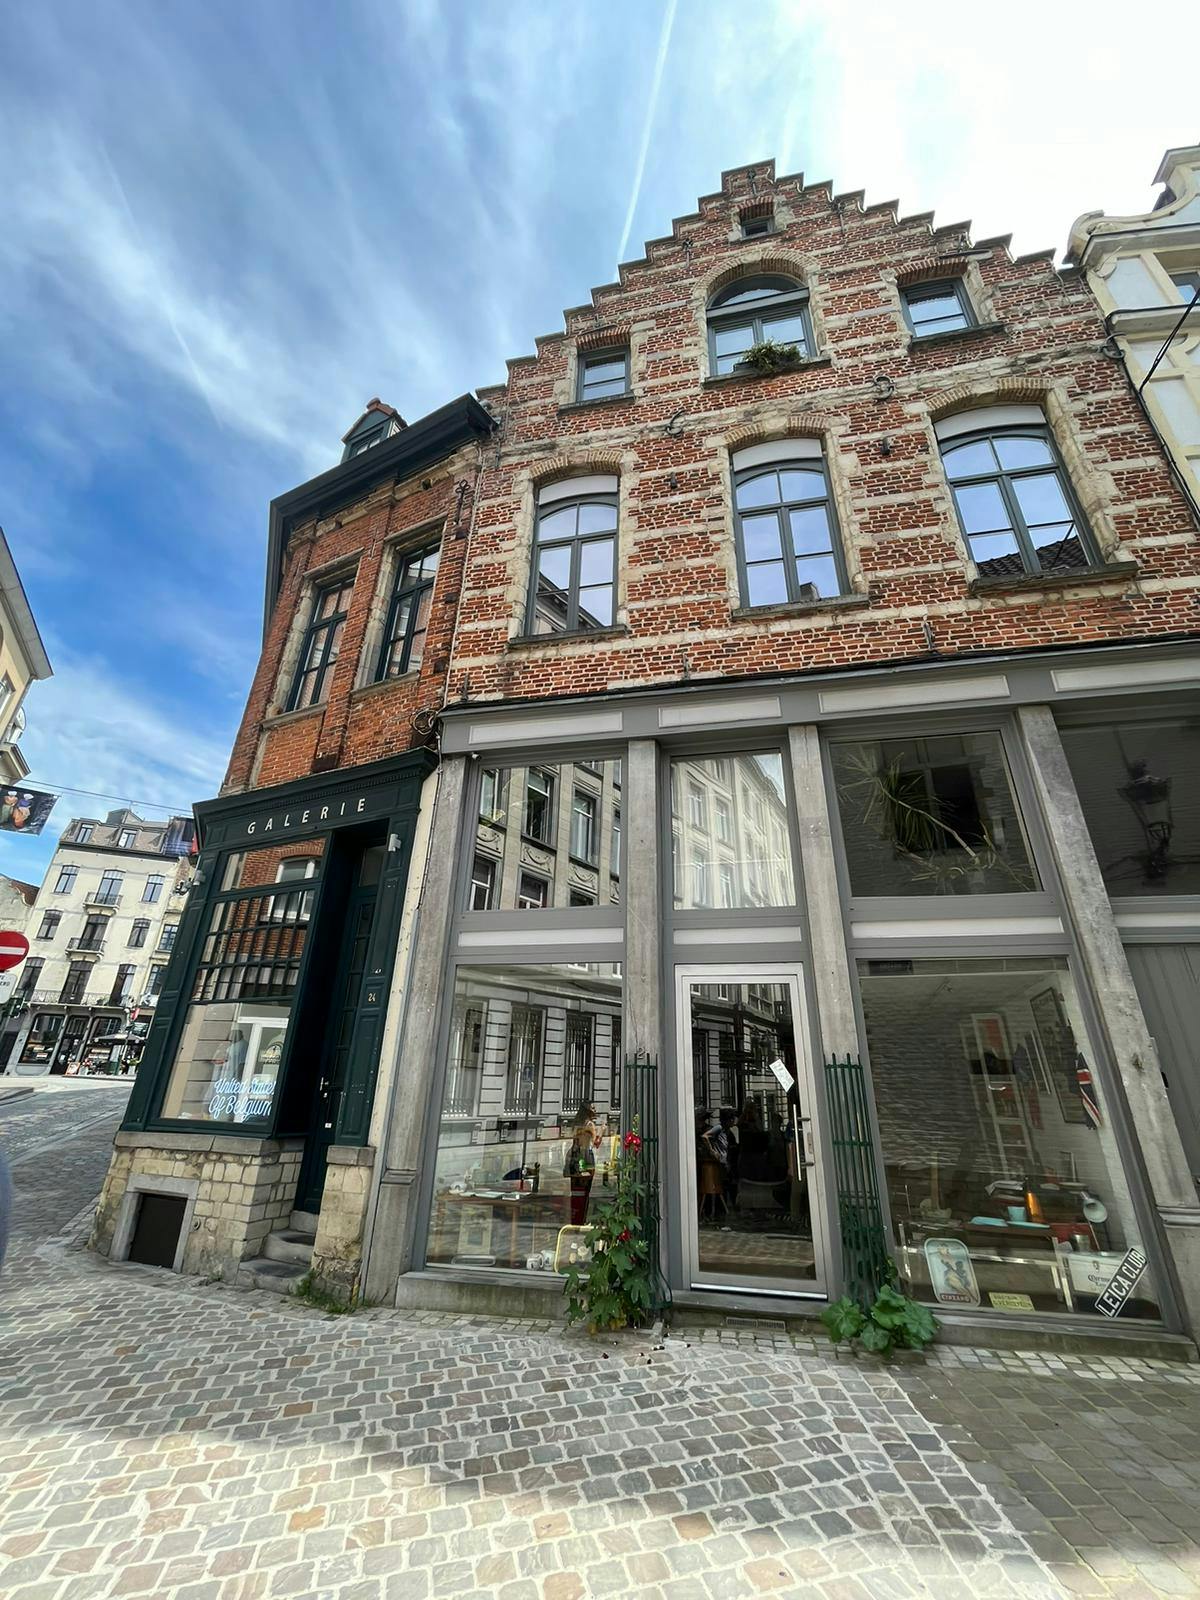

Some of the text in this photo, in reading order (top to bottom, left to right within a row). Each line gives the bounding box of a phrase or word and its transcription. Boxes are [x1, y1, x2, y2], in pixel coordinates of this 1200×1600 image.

[247, 798, 366, 834] GALERIE
[214, 1077, 247, 1094] United
[208, 1094, 273, 1121] Of Belgium
[1098, 1250, 1147, 1317] LEICA CLUB
